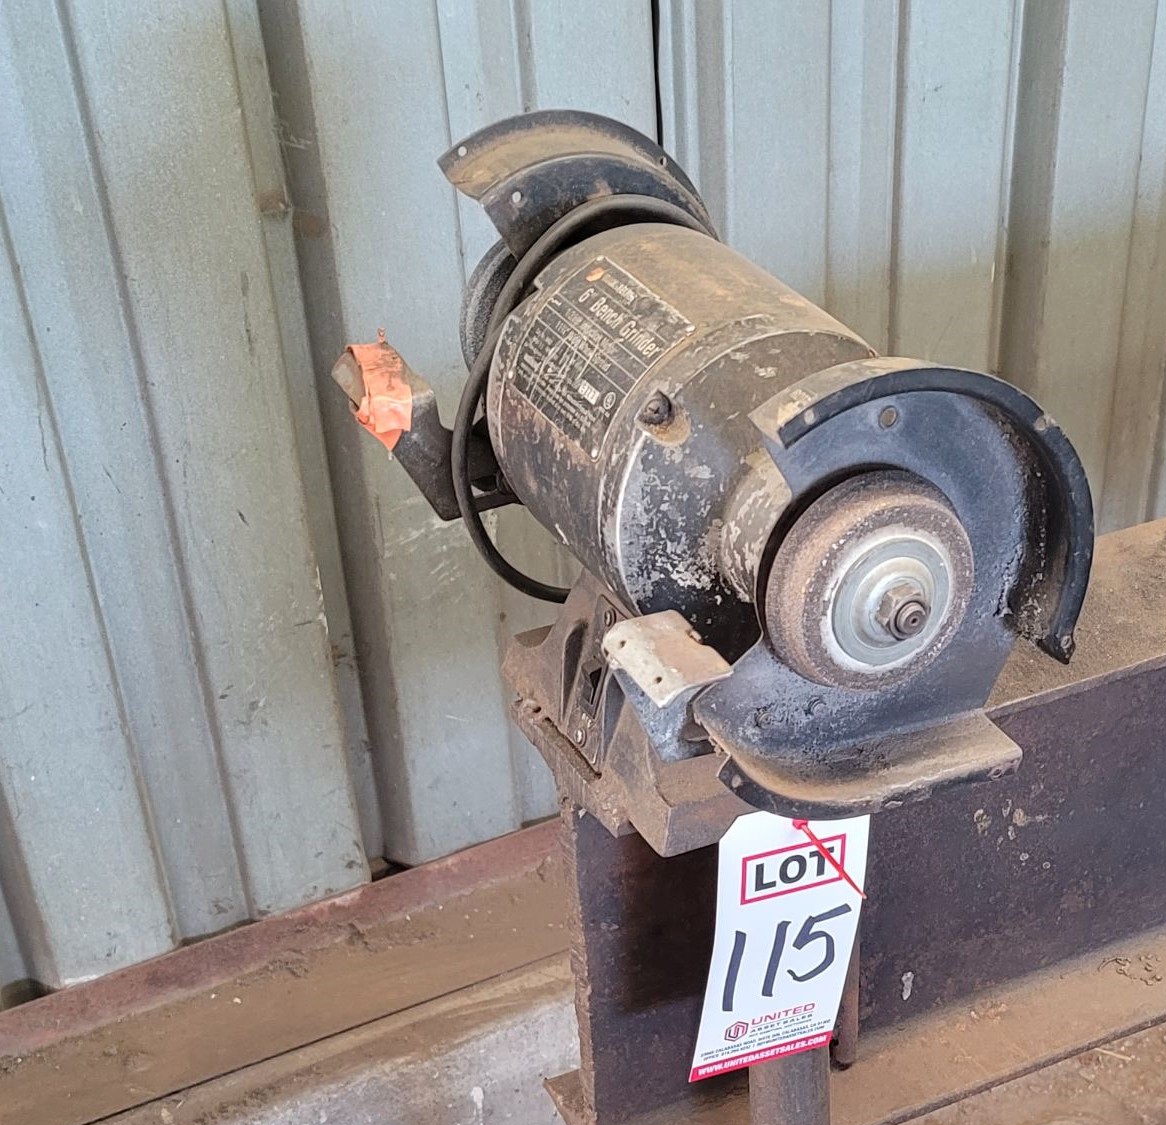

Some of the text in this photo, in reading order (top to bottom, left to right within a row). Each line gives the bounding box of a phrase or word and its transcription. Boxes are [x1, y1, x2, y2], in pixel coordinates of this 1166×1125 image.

[589, 297, 624, 330] Bench
[618, 320, 661, 357] Grinder
[754, 846, 835, 892] LOT
[722, 903, 852, 1012] 115
[751, 1003, 815, 1025] UNITED
[698, 1035, 827, 1075] WWW.UNITEDASSETSALES.COM
